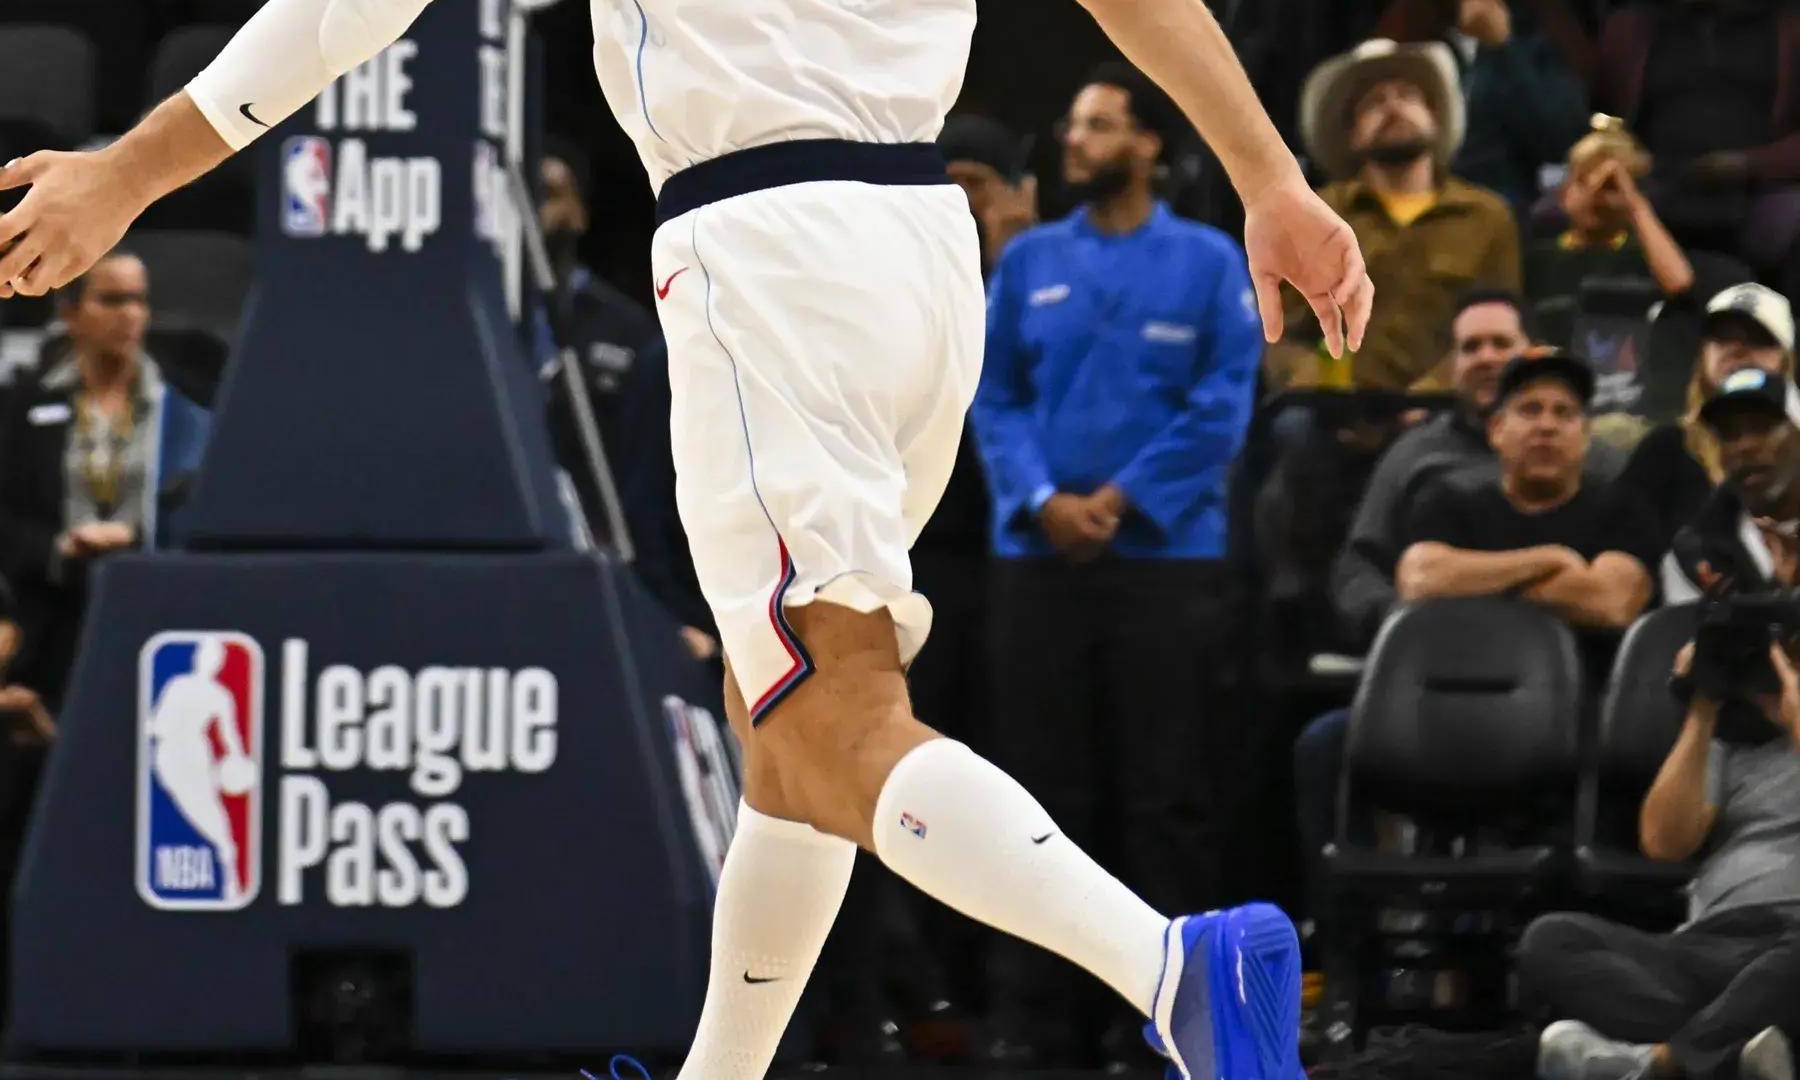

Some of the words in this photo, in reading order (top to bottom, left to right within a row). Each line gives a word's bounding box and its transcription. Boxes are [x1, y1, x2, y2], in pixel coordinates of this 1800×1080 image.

[332, 137, 442, 252] App
[282, 638, 558, 797] League
[157, 844, 215, 890] NBA
[278, 774, 470, 908] Pass
